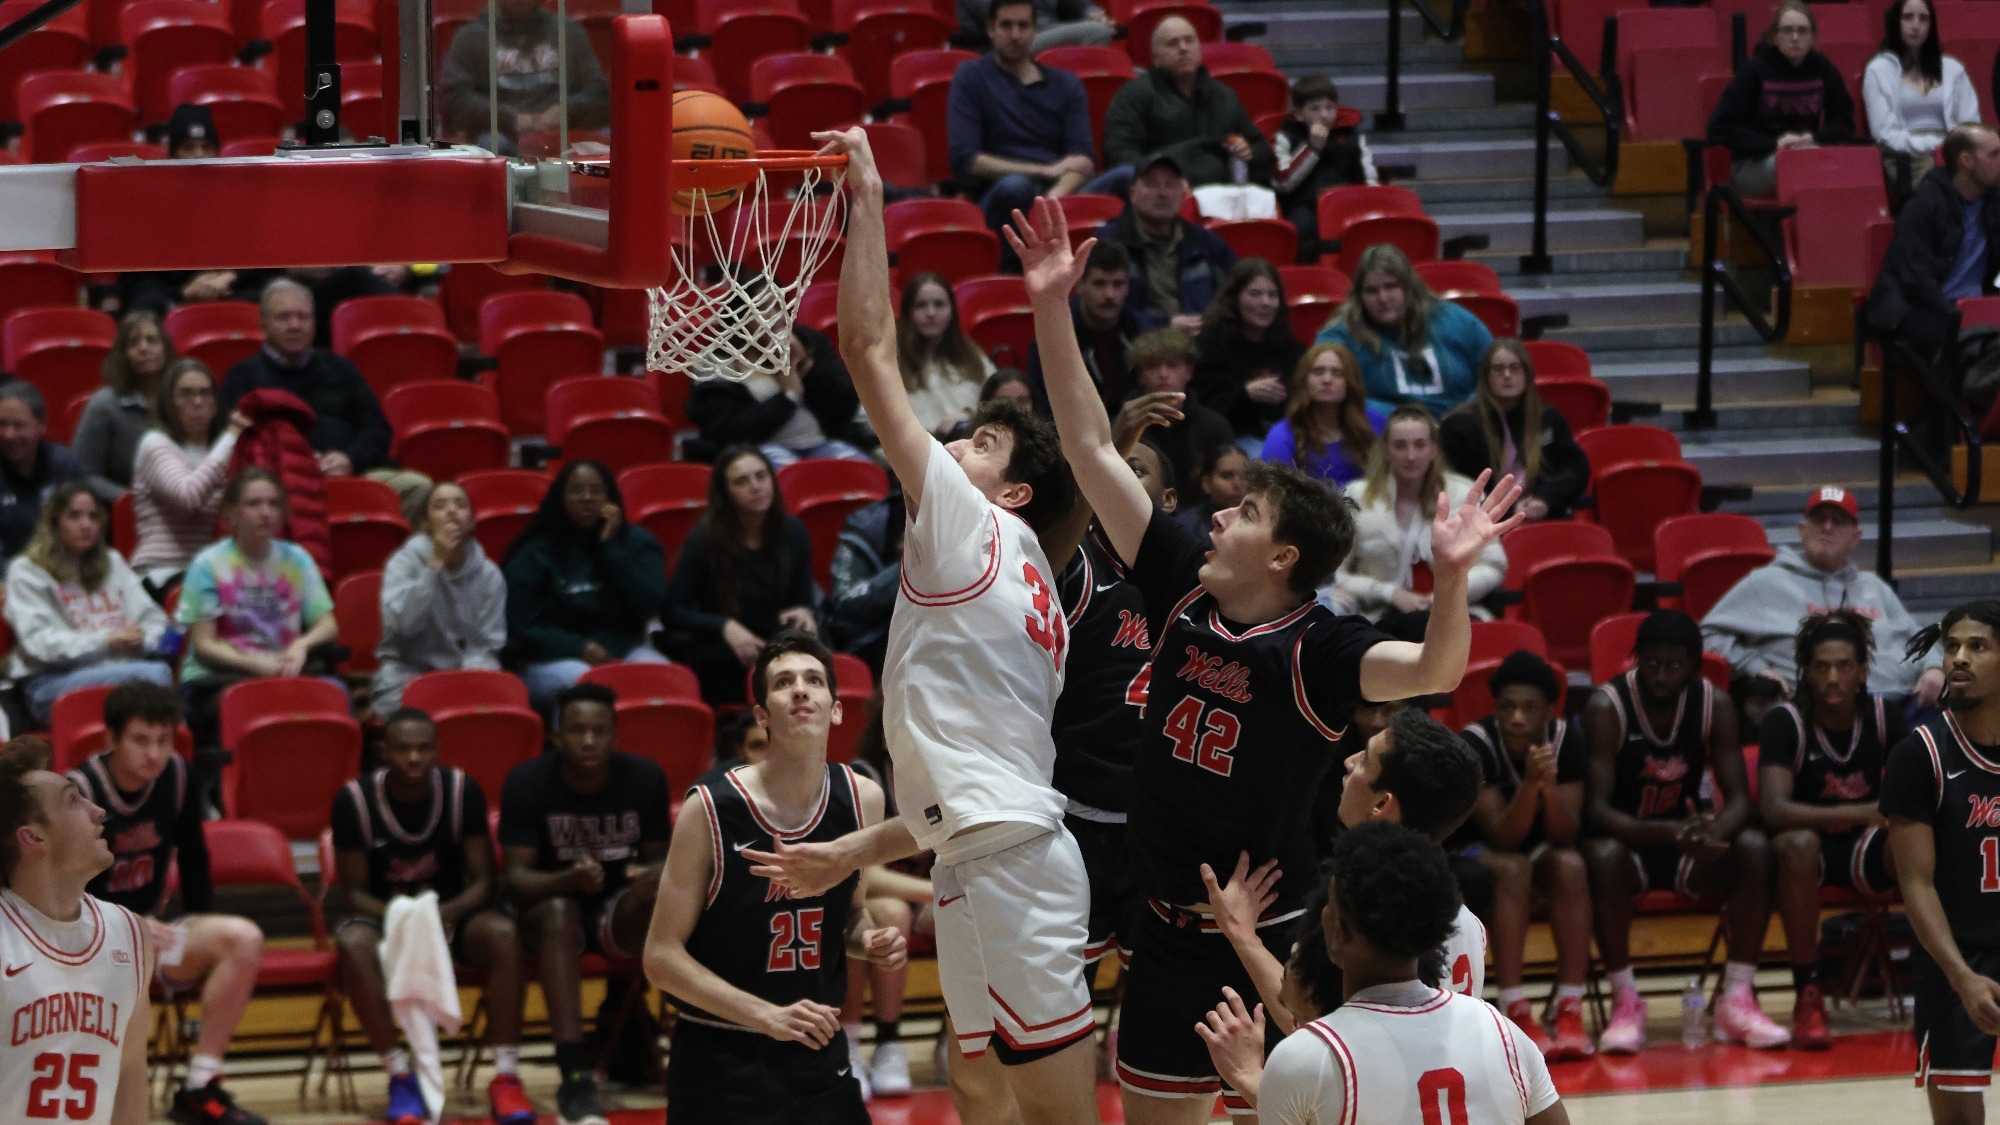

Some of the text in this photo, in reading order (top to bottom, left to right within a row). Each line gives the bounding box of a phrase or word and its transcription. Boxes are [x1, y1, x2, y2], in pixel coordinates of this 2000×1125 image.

[1176, 645, 1252, 703] Wells
[1163, 694, 1241, 777] 42
[766, 907, 824, 973] 25
[11, 991, 119, 1047] CORNELL
[26, 1052, 100, 1121] 25
